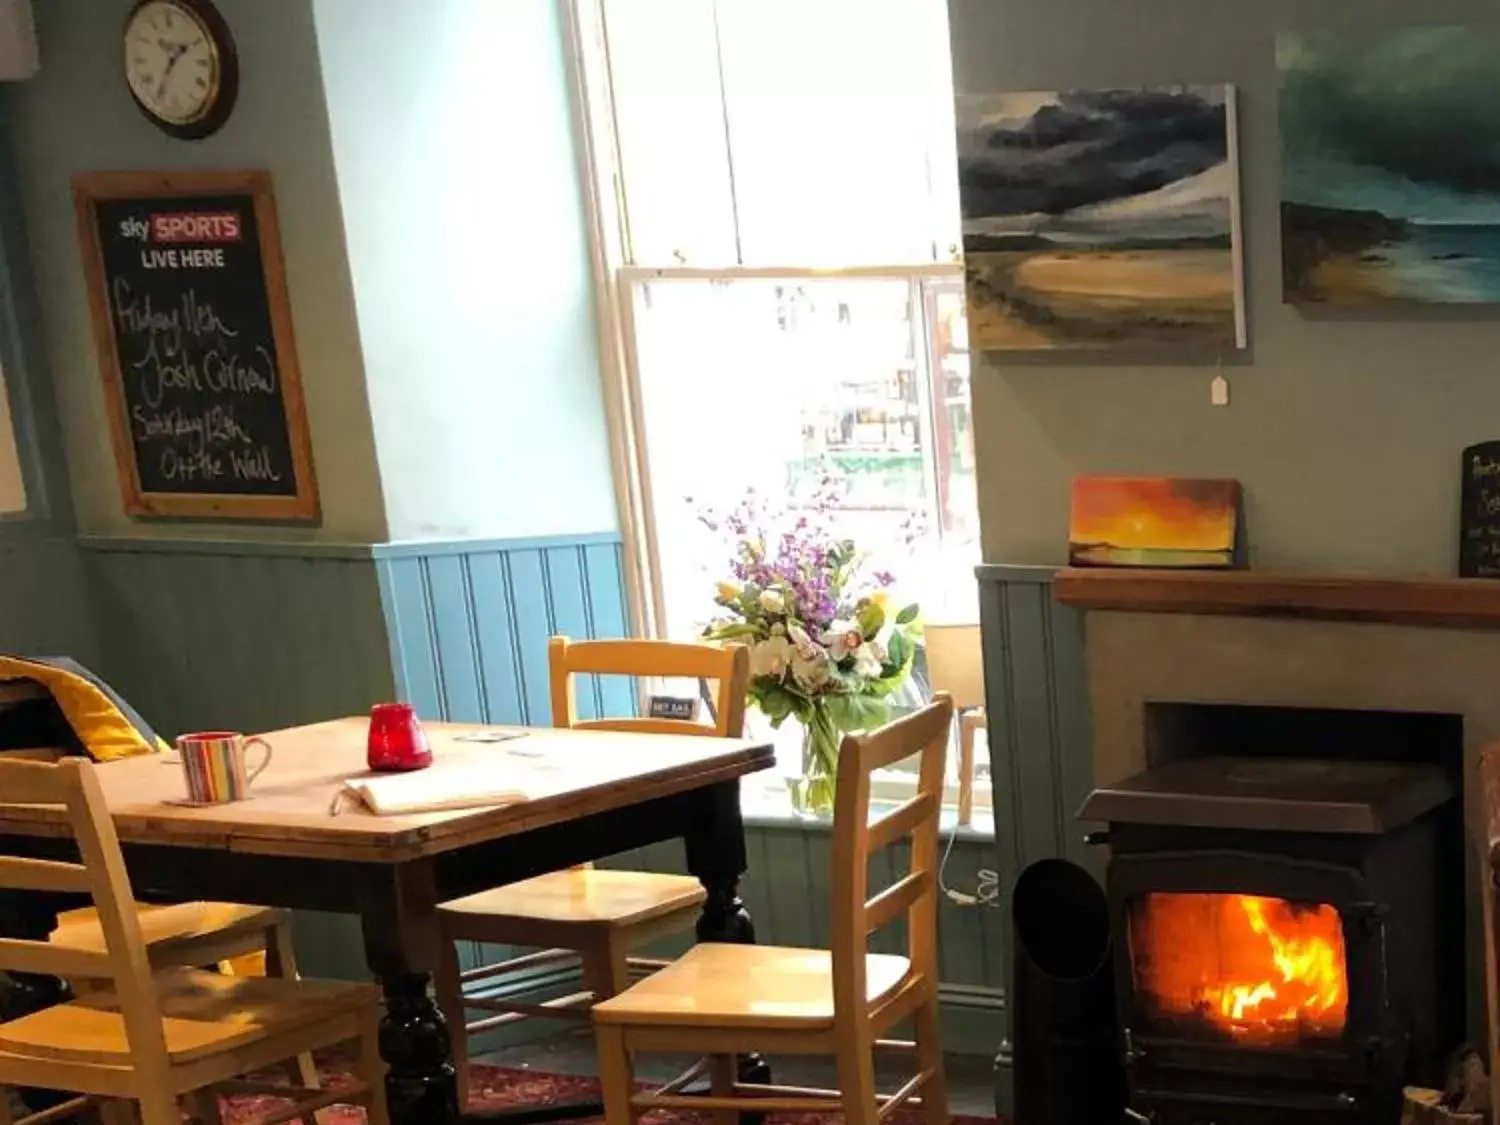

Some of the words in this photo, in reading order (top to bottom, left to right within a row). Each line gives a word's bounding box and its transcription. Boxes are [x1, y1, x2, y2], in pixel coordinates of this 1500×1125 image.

[119, 217, 149, 242] sky
[155, 214, 239, 240] SPORTS
[142, 250, 179, 268] LIVE
[182, 249, 225, 267] HERE
[132, 345, 203, 408] Josh
[229, 446, 282, 482] Wall
